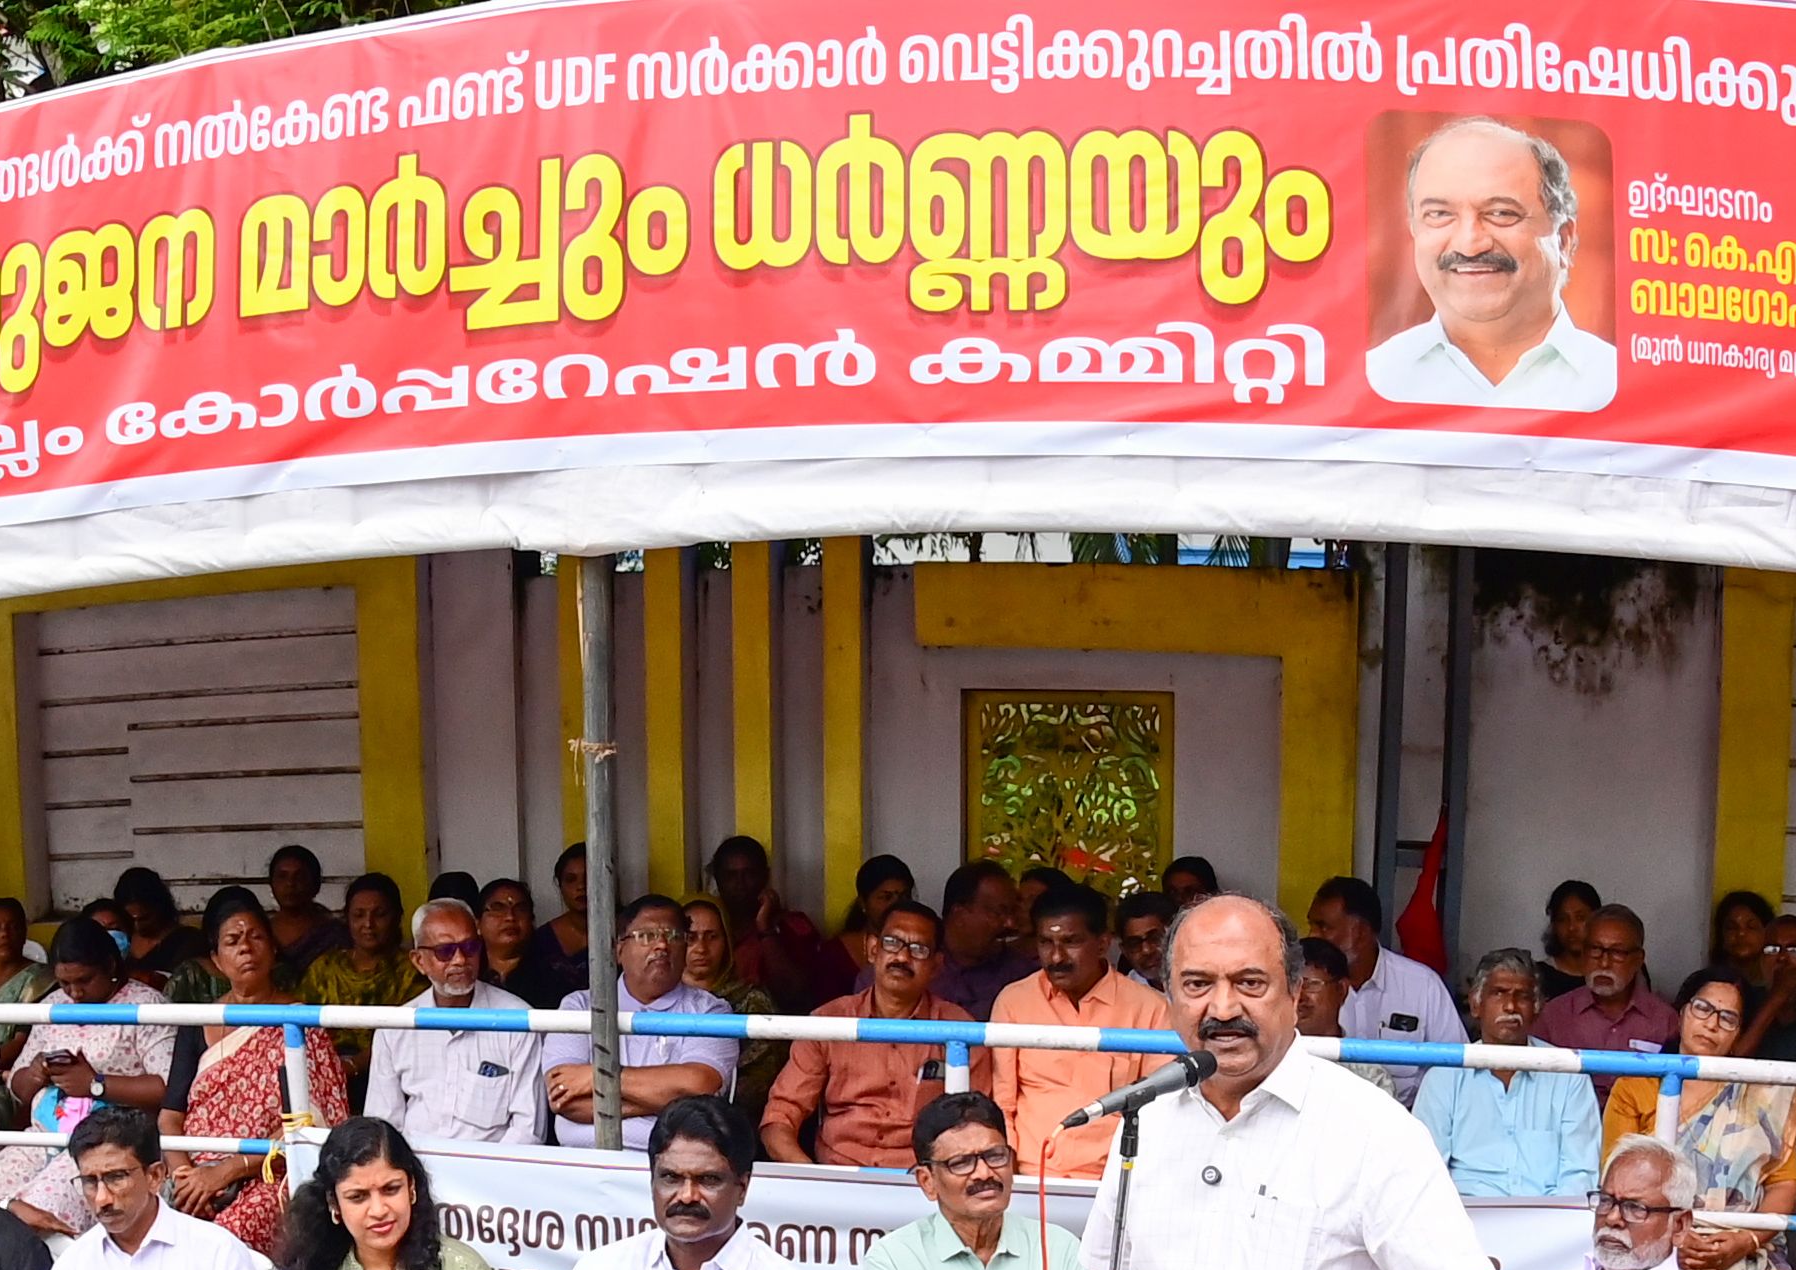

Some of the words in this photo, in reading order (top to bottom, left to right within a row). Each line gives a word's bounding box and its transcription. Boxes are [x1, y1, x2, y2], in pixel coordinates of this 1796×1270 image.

[154, 86, 390, 168] നൽകേണ്ട
[398, 50, 530, 130] ഫണ്ട്
[535, 53, 616, 110] UDF
[626, 26, 887, 100] സർക്കാർ
[899, 13, 1383, 96] വെട്ടിക്കുറച്ചതിൽ
[239, 153, 689, 332] മാർച്ചും
[712, 112, 1332, 312] ധർണ്ണയും
[105, 329, 876, 446] കോർപ്പറേഷൻ
[909, 322, 1326, 405] കമ്മിറ്റി
[1631, 333, 1683, 365] (മുൻ
[1688, 341, 1775, 379] ധനകാര്യ
